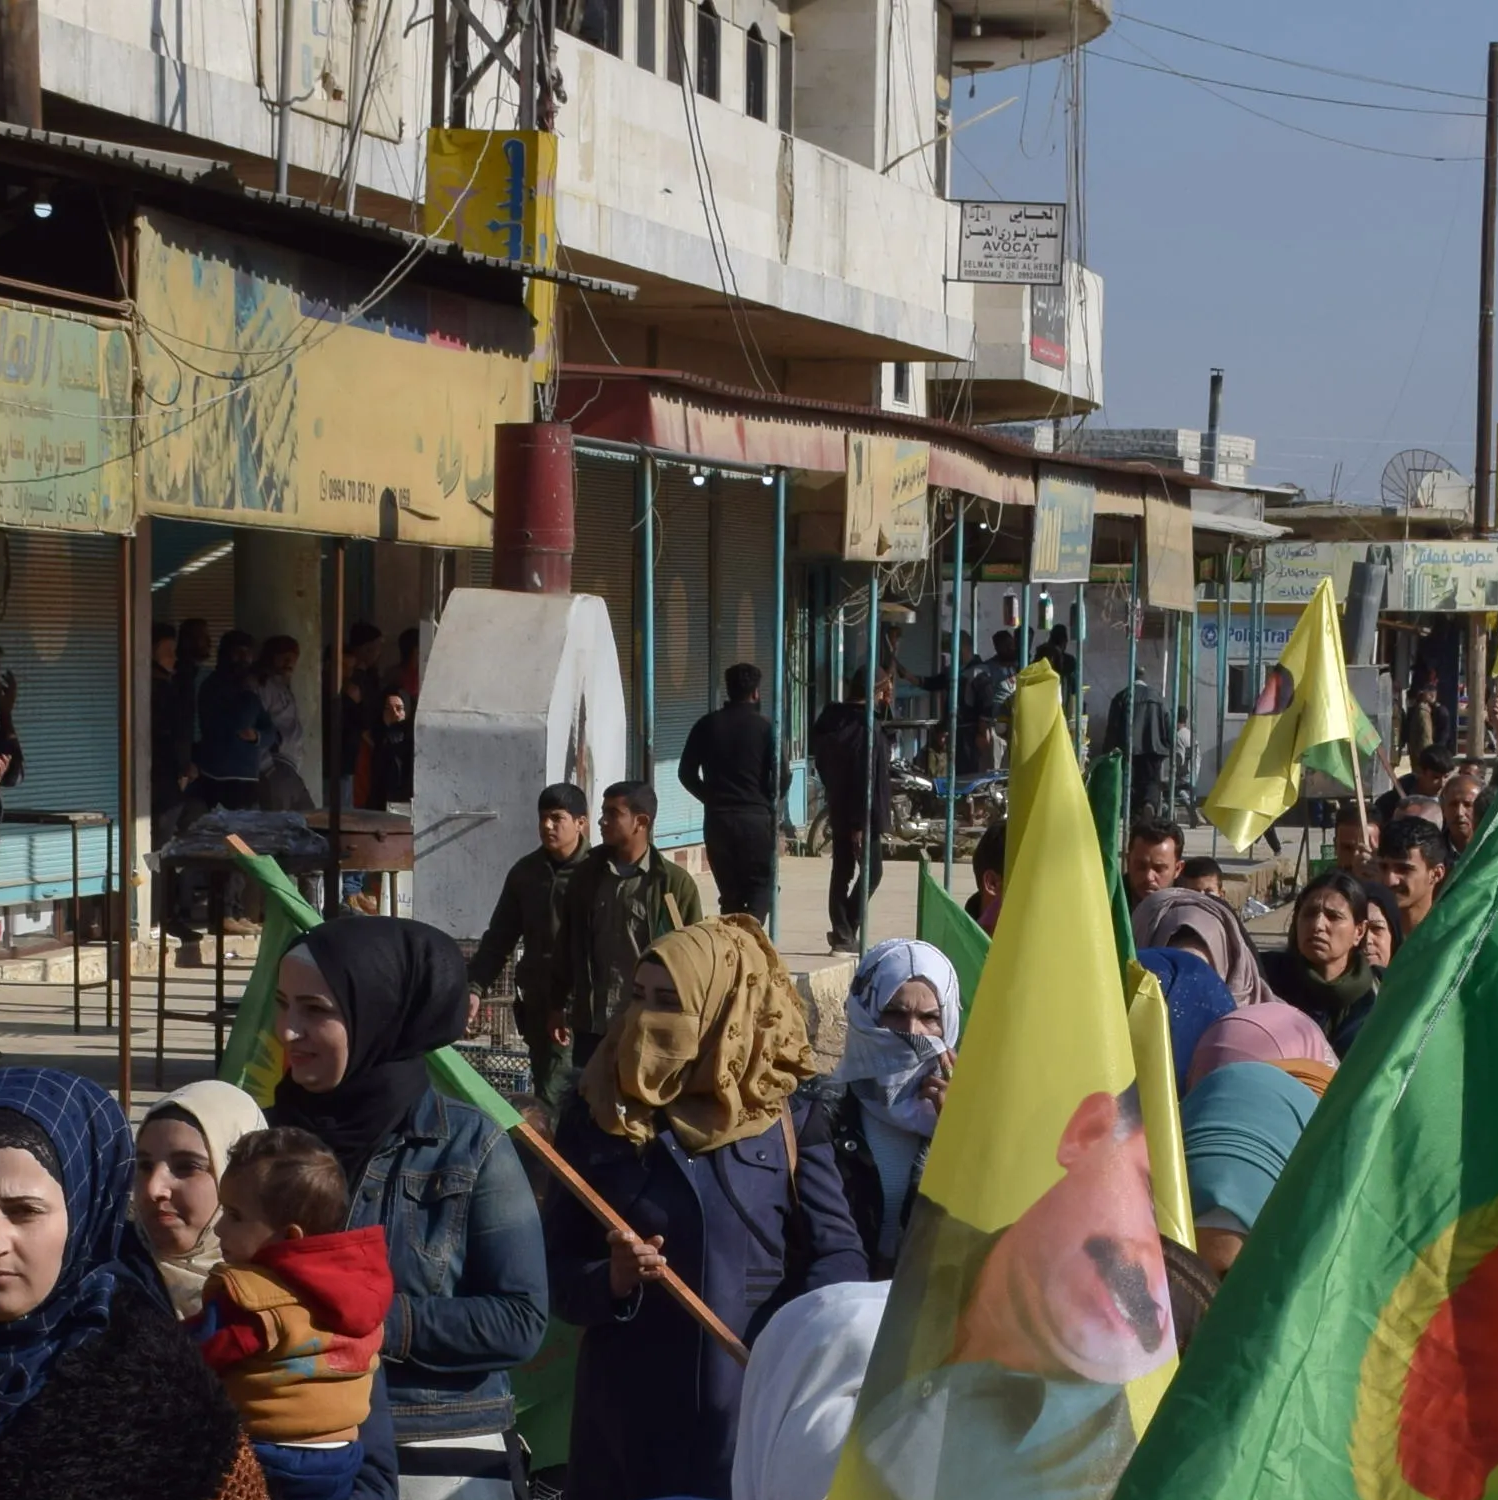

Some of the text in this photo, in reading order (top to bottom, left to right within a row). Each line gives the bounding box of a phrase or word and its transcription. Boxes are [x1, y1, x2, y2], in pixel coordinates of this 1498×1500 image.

[486, 138, 537, 261] صيدلي
[1009, 205, 1058, 224] المحامي
[964, 224, 997, 239] الحسن
[1029, 226, 1058, 242] سلمان
[982, 240, 1040, 253] AVOCAT
[328, 478, 346, 501] 0994
[347, 480, 356, 502] 70
[1452, 547, 1494, 567] عطورات
